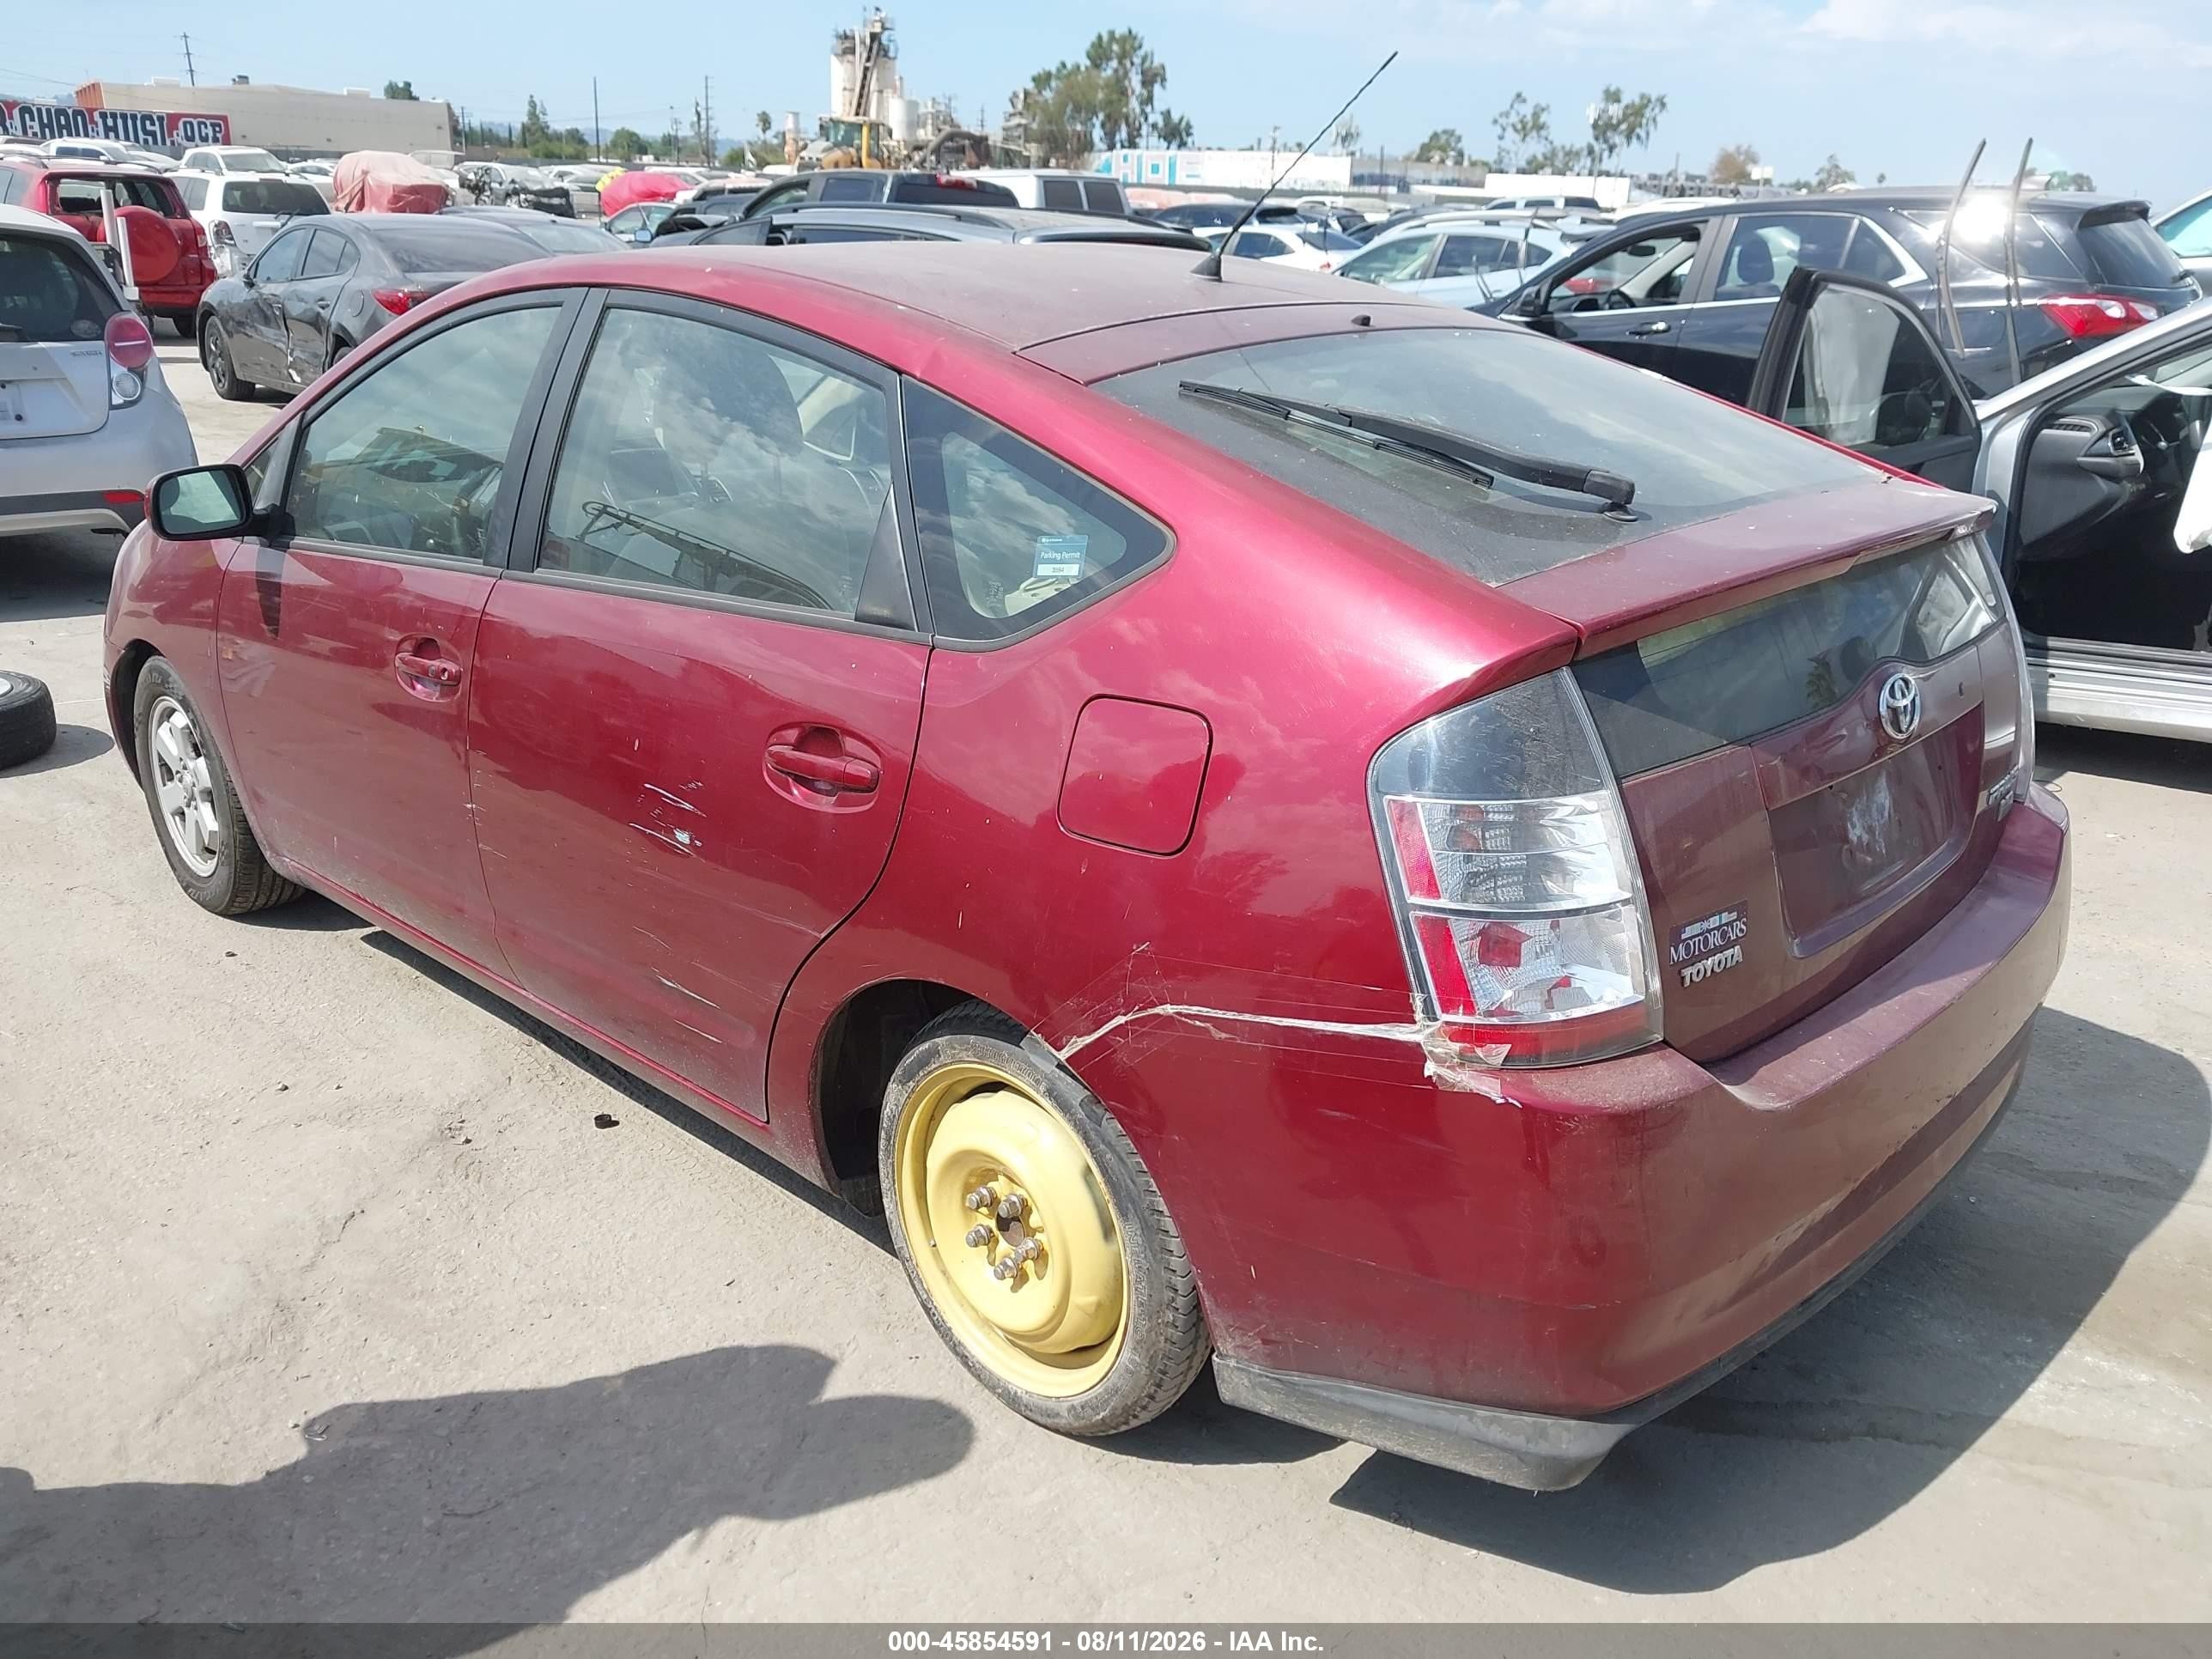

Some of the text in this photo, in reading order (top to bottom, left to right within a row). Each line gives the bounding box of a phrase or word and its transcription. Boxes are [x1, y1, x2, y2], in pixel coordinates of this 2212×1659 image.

[1040, 550, 1061, 561] Parking
[1669, 918, 1747, 965] MOTORCARS
[1680, 945, 1743, 988] TOYOTA
